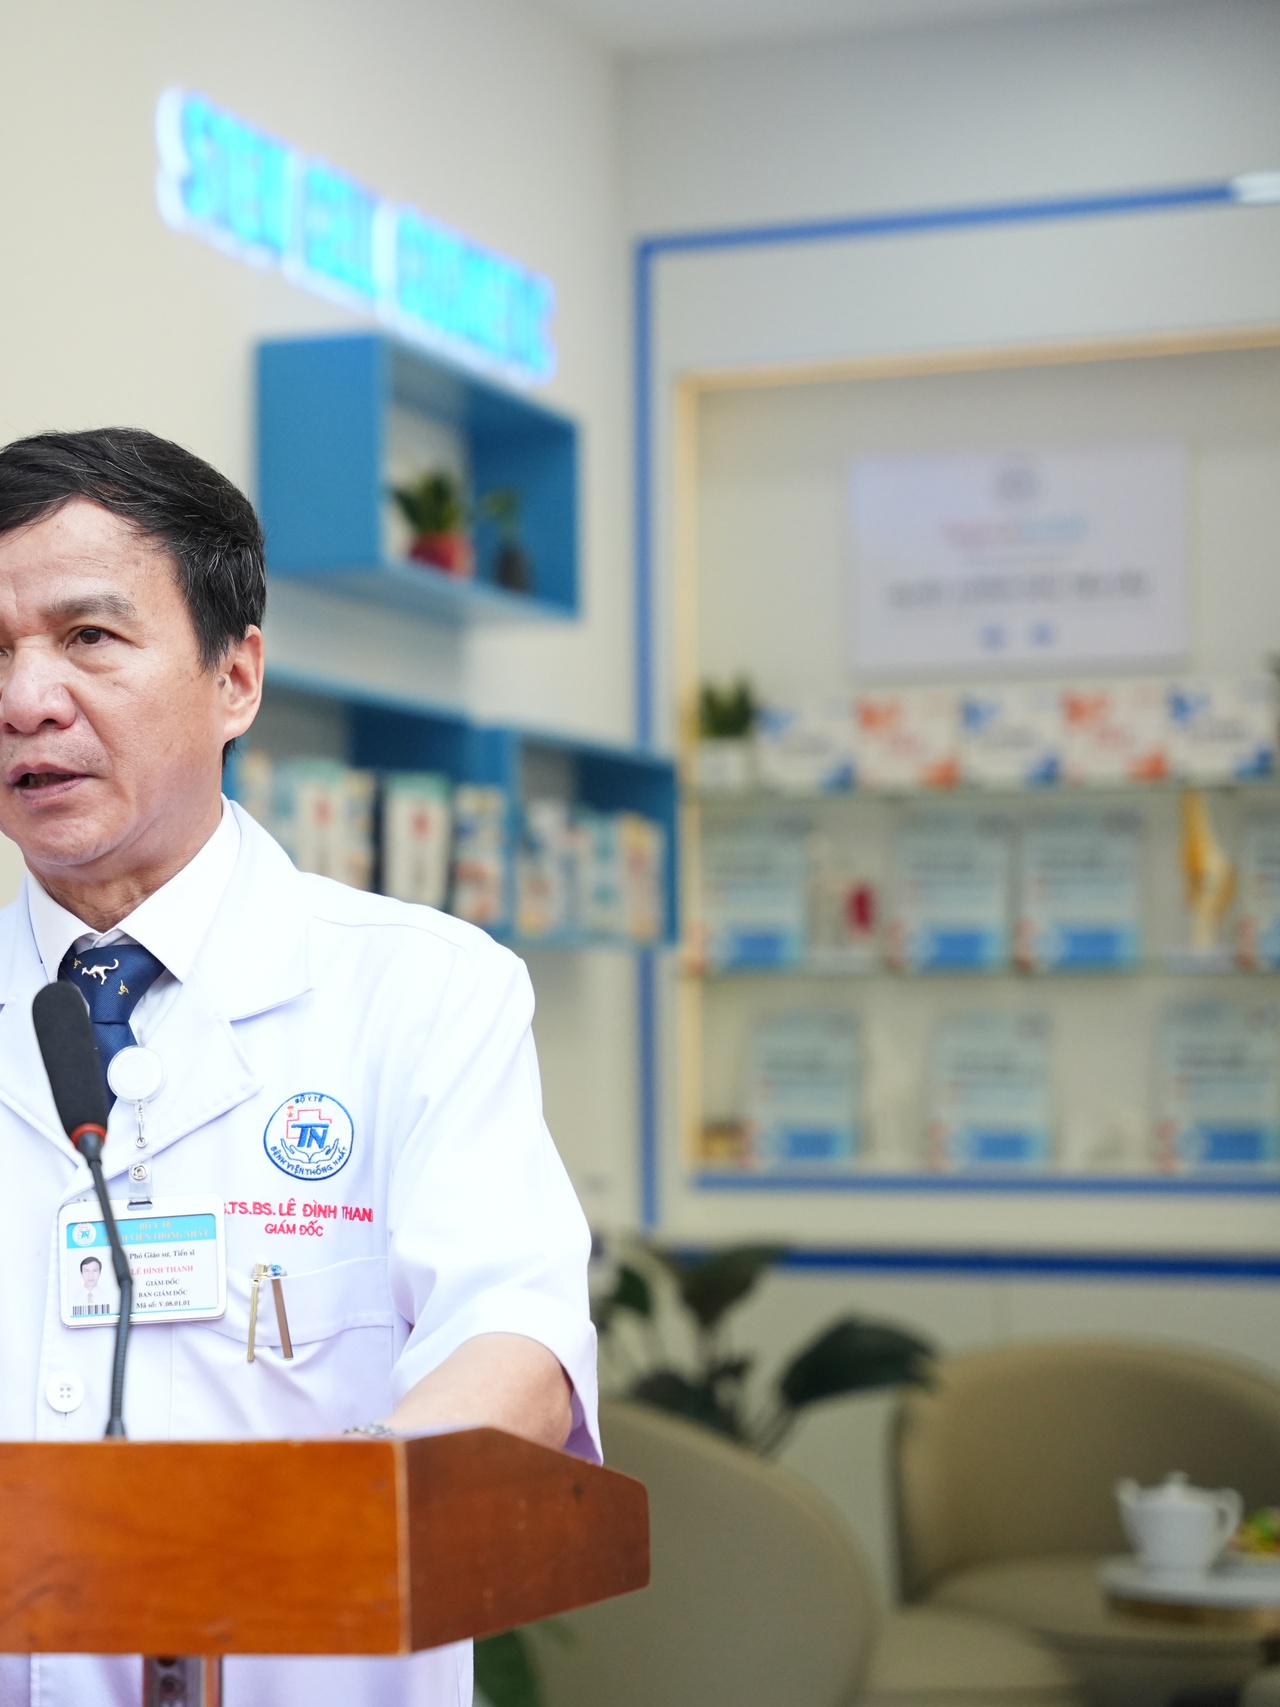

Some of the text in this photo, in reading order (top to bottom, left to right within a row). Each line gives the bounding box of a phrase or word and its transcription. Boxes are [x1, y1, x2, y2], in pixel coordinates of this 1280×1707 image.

[291, 1124, 329, 1149] TN
[224, 1201, 276, 1215] .TS.BS.
[278, 1198, 296, 1216] LÊ
[302, 1200, 337, 1219] ĐÌNH
[264, 1220, 324, 1237] GIÁM ĐỐC
[129, 1252, 143, 1260] Phó
[144, 1251, 160, 1259] Giáo
[173, 1249, 188, 1257] Tiến
[131, 1266, 141, 1276] LÊ
[165, 1265, 194, 1273] THANH
[145, 1279, 164, 1287] GIÁM
